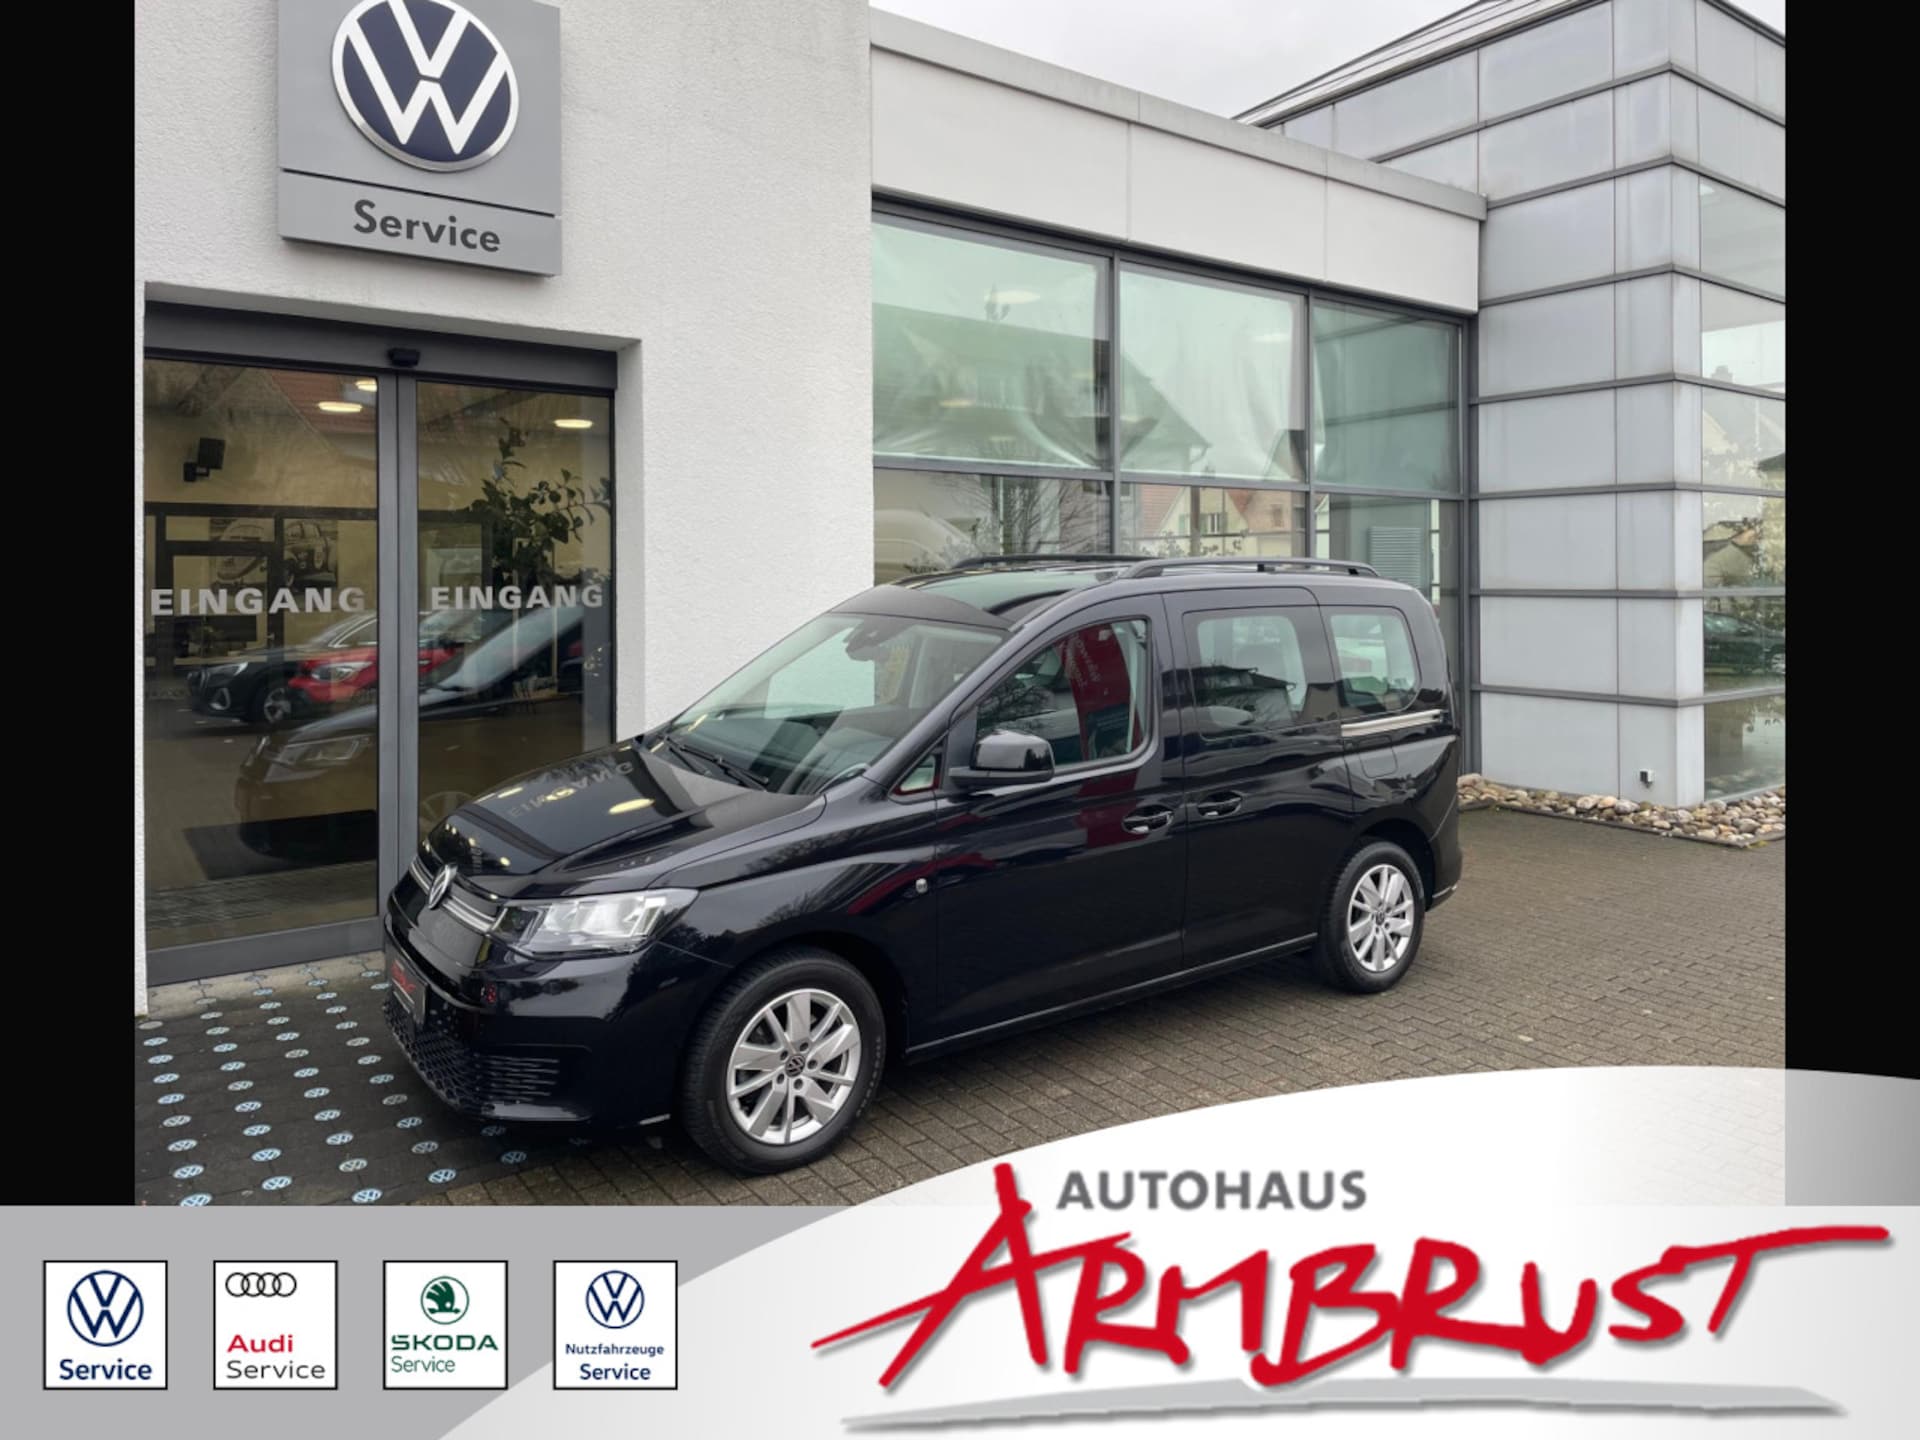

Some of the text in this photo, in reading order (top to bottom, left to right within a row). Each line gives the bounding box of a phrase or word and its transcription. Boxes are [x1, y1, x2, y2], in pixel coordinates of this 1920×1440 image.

[353, 199, 501, 253] Service
[150, 586, 366, 617] EINGANG
[431, 583, 604, 611] EINGANG
